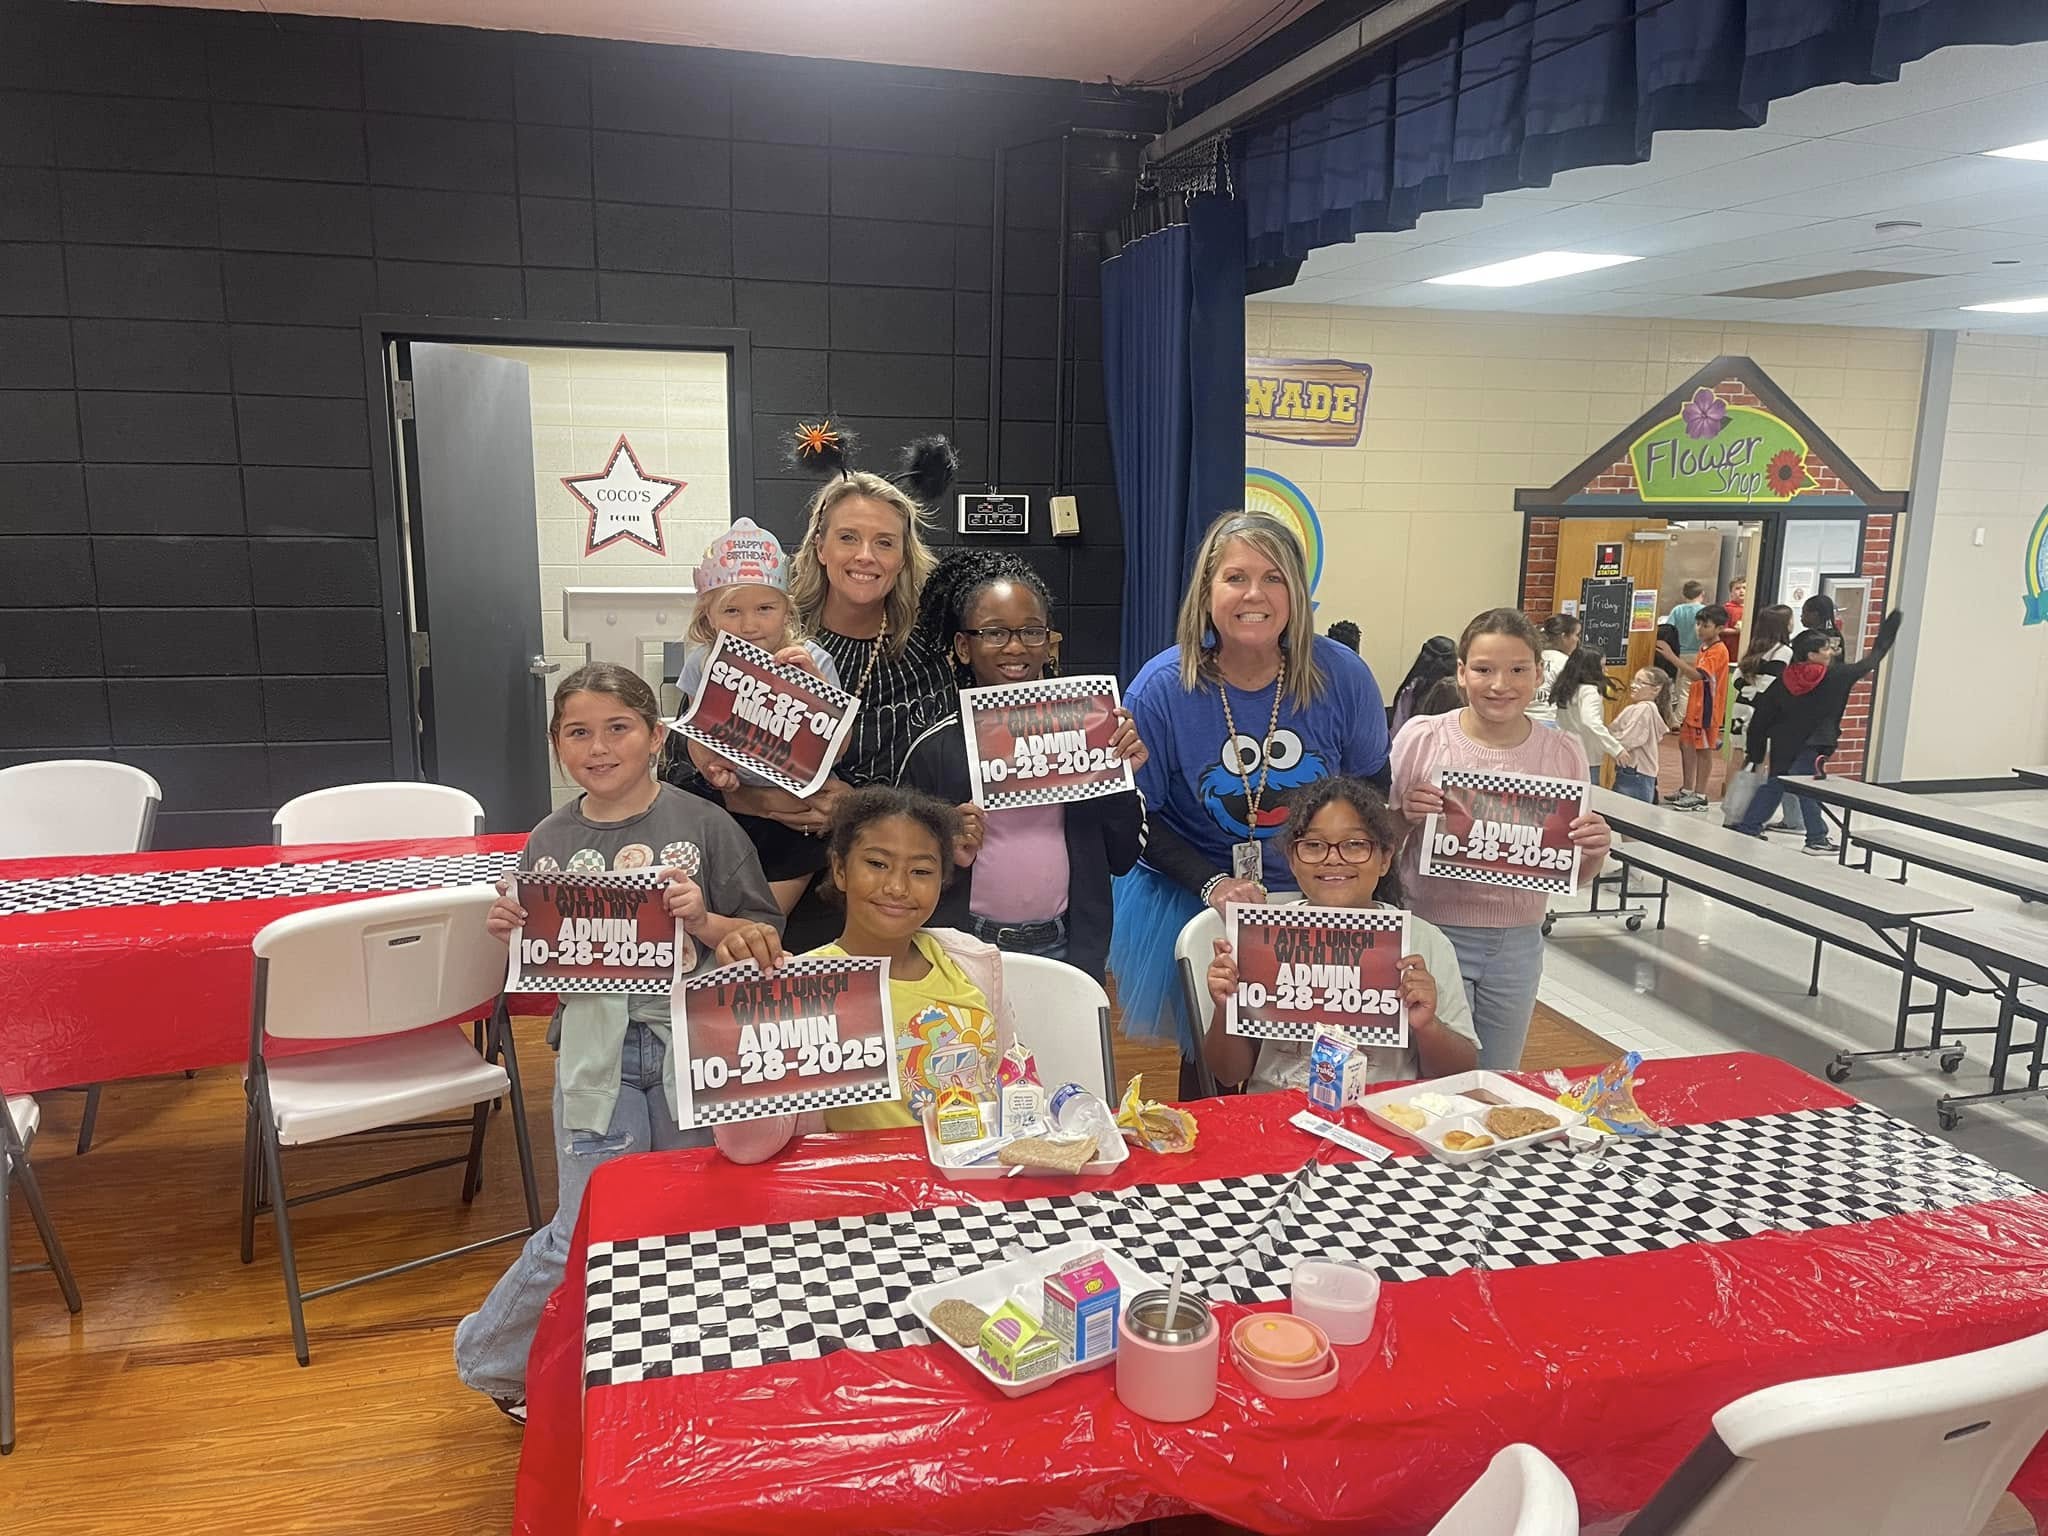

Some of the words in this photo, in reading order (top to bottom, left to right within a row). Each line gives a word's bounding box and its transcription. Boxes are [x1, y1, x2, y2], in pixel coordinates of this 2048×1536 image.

[1246, 378, 1359, 424] NADE
[1647, 437, 1763, 483] Flower
[597, 489, 651, 502] COCO'S
[1709, 464, 1761, 503] Shop
[726, 551, 772, 561] BIRTHDAY
[733, 540, 763, 550] HAPPY
[1591, 594, 1621, 614] Friday
[710, 661, 841, 741] 10-28-2025
[732, 694, 801, 742] ADMIN
[1014, 729, 1087, 758] ADMIN
[980, 747, 1122, 783] 10-28-2025
[1468, 819, 1543, 848] ADMIN
[1434, 833, 1573, 871] 10-28-2025
[556, 886, 590, 902] ATE
[594, 886, 649, 903] LUNCH
[612, 900, 641, 918] MY
[557, 917, 637, 943] ADMIN
[1263, 928, 1270, 944] I
[1275, 928, 1311, 946] ATE
[1315, 930, 1375, 949] LUNCH
[521, 939, 673, 968] 10-28-2025
[1274, 943, 1327, 963] WITH
[1333, 945, 1366, 966] MY
[717, 985, 725, 1007] I
[733, 980, 775, 1005] ATE
[781, 973, 849, 999] LUNCH
[1276, 962, 1361, 990] ADMIN
[730, 995, 796, 1023] WITH
[800, 992, 840, 1017] MY
[1238, 982, 1399, 1015] 10-28-2025
[738, 1014, 839, 1055] ADMIN
[691, 1036, 886, 1090] 10-28-2025
